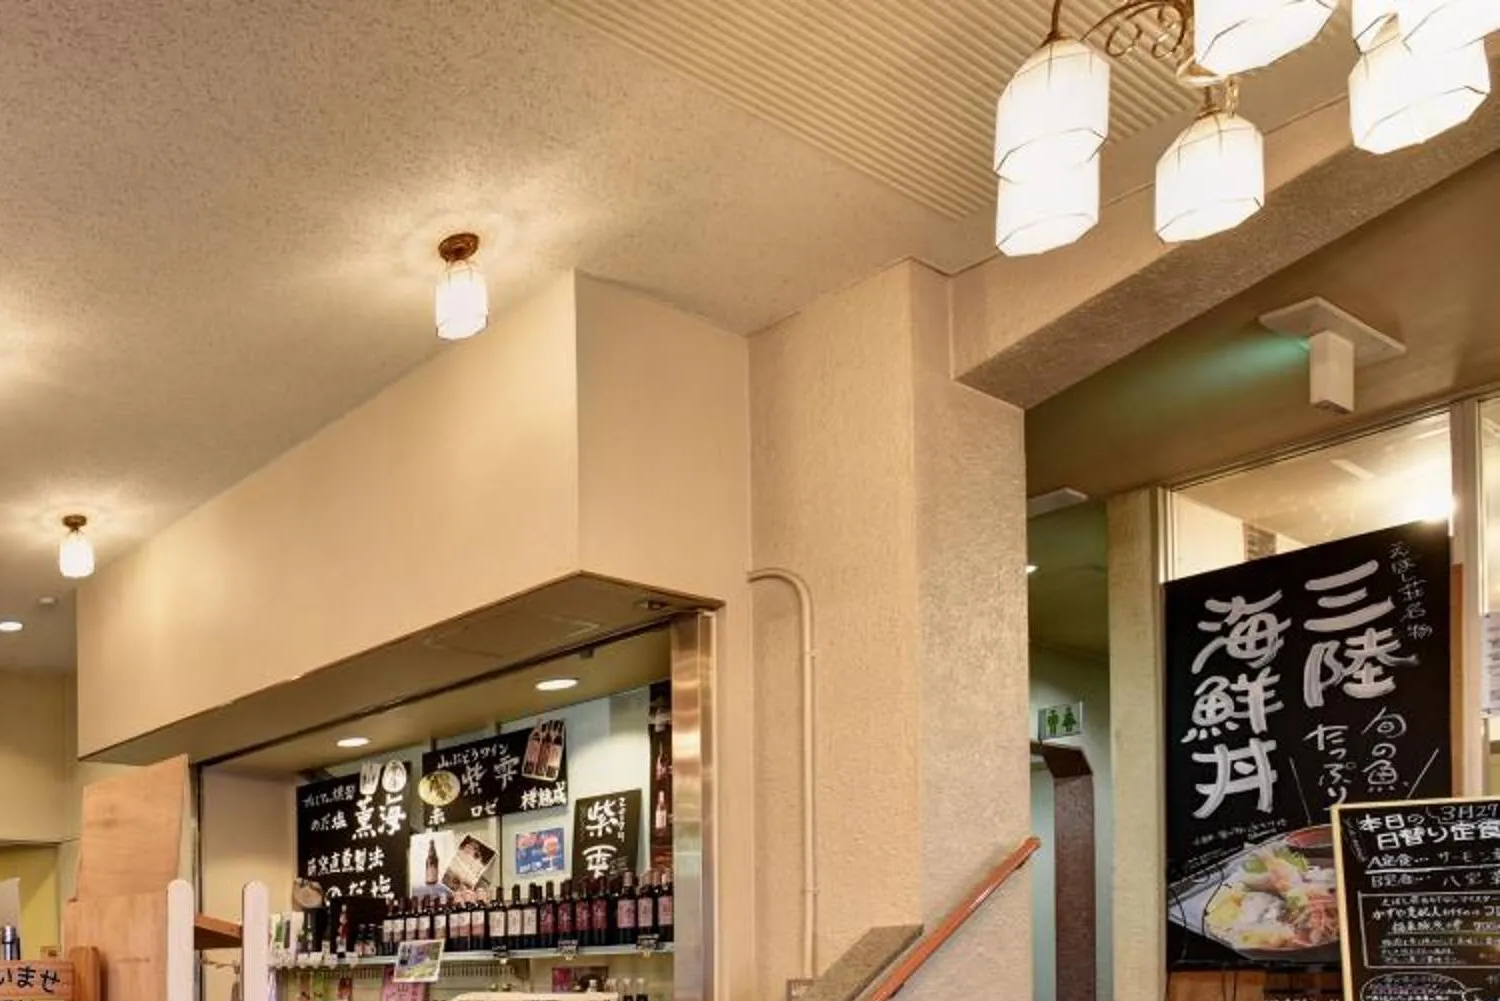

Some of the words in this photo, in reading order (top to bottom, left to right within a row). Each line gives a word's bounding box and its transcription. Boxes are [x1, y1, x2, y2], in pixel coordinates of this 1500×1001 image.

[1303, 559, 1419, 708] 三陸
[1180, 589, 1292, 820] 海鮮丼
[437, 743, 509, 769] 山ぶどうワイン
[1359, 813, 1425, 833] 本日の
